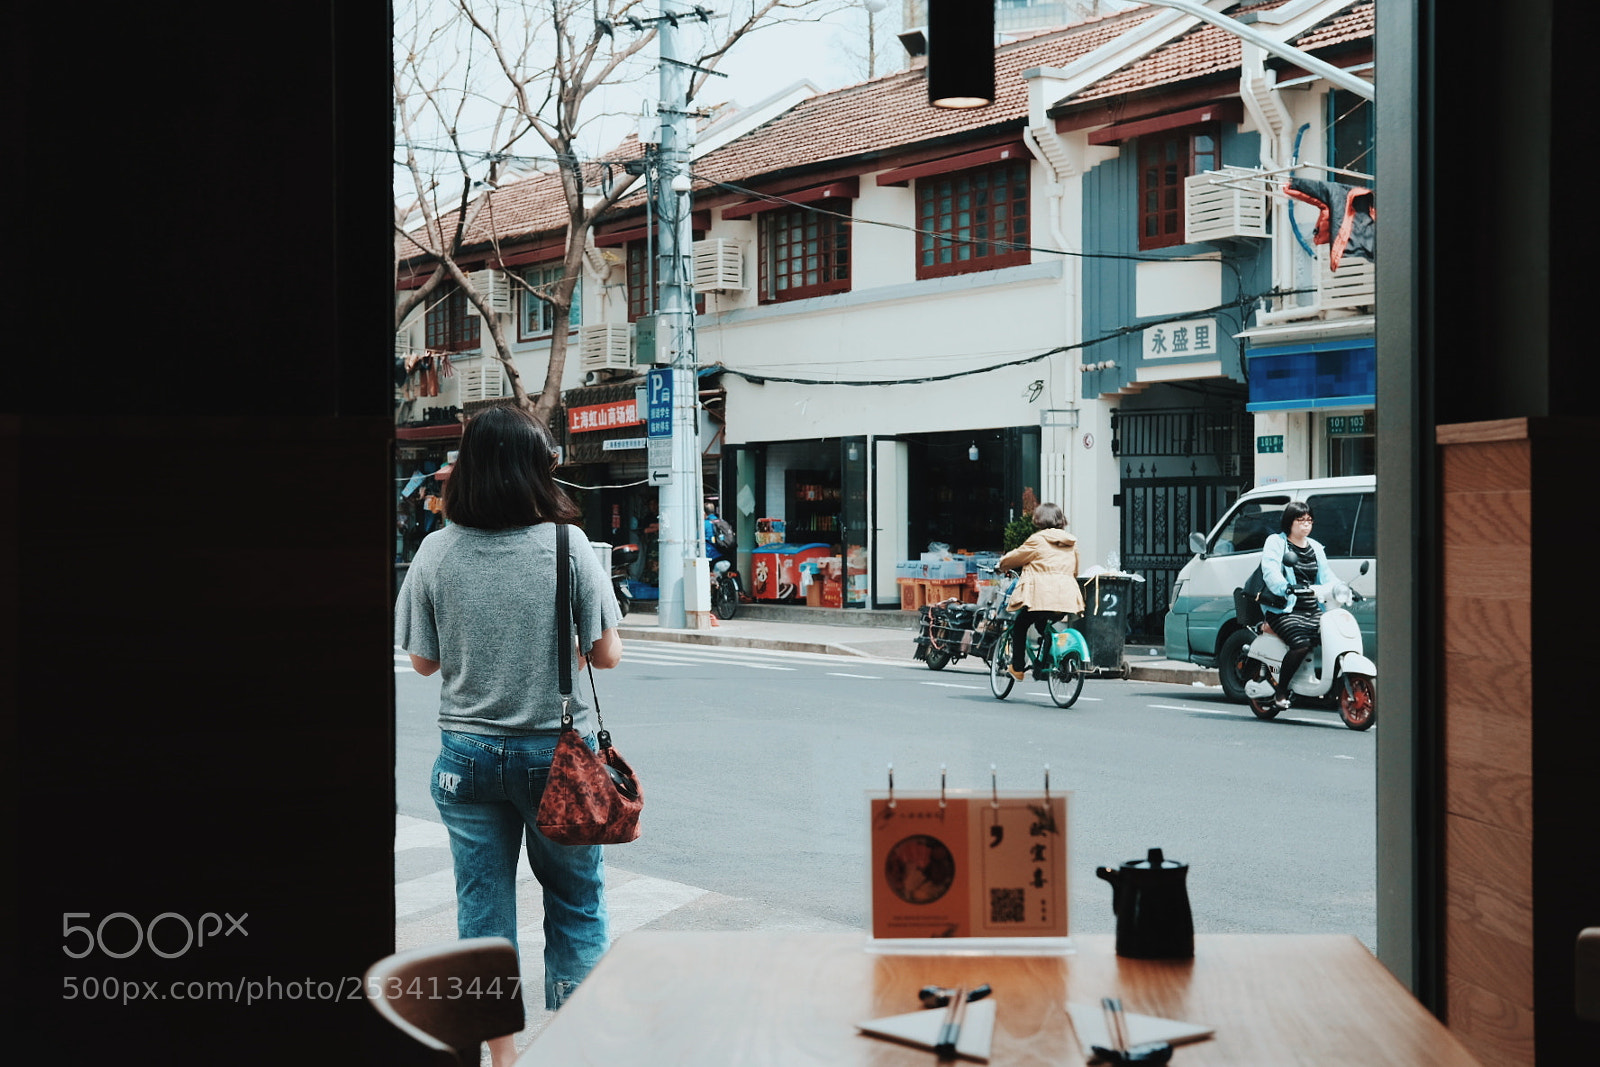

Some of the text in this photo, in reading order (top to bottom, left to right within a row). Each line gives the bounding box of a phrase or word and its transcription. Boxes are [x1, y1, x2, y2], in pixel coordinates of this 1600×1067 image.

[1151, 325, 1211, 354] 永盛里
[651, 374, 662, 404] P
[1330, 417, 1345, 428] 101
[1350, 416, 1364, 427] 103
[1102, 593, 1118, 617] 2
